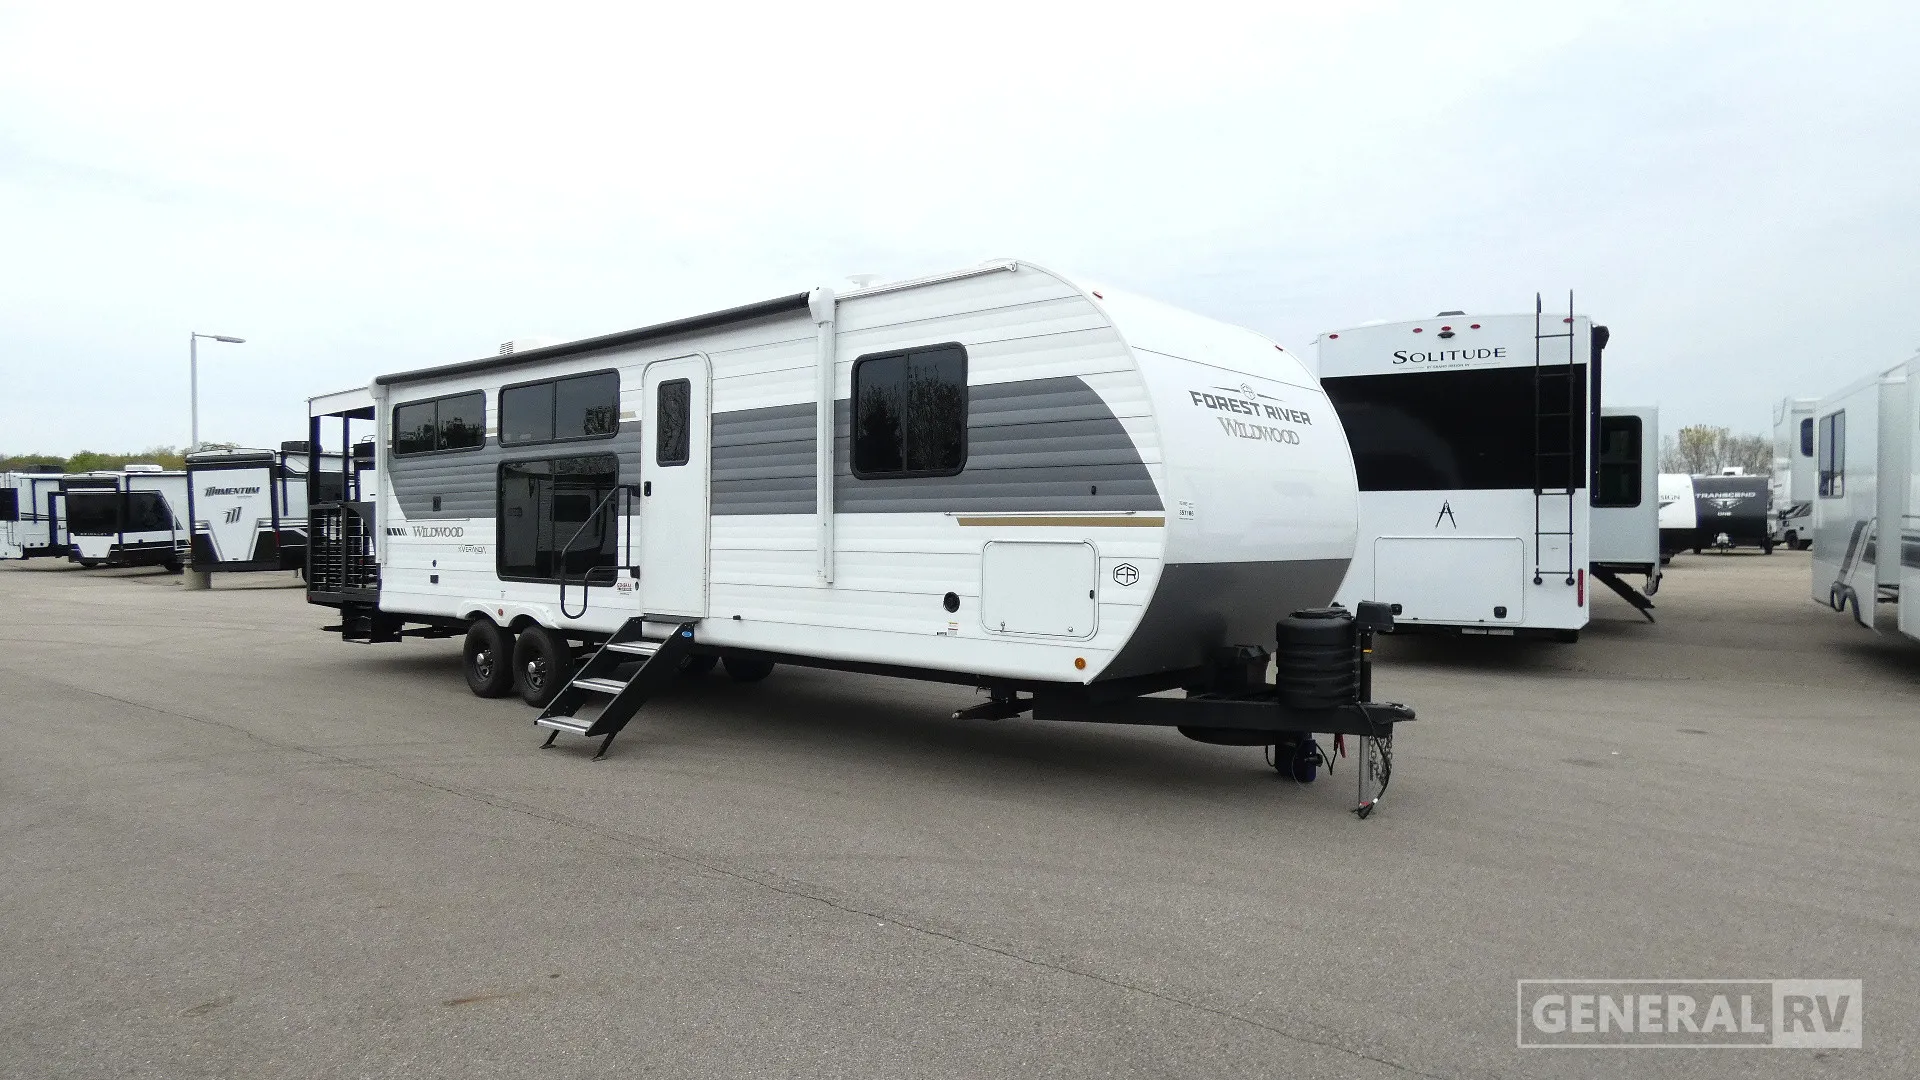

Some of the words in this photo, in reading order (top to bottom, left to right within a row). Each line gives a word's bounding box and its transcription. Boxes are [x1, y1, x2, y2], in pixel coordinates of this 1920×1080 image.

[1392, 347, 1507, 365] SOLITUDE
[1189, 390, 1261, 417] FOREST
[1263, 404, 1313, 426] RIVER
[1217, 416, 1300, 446] WILDWOOD
[204, 486, 261, 497] MOMENTUM
[1695, 491, 1757, 499] TRANSCEND
[412, 525, 464, 538] WILDWOOD
